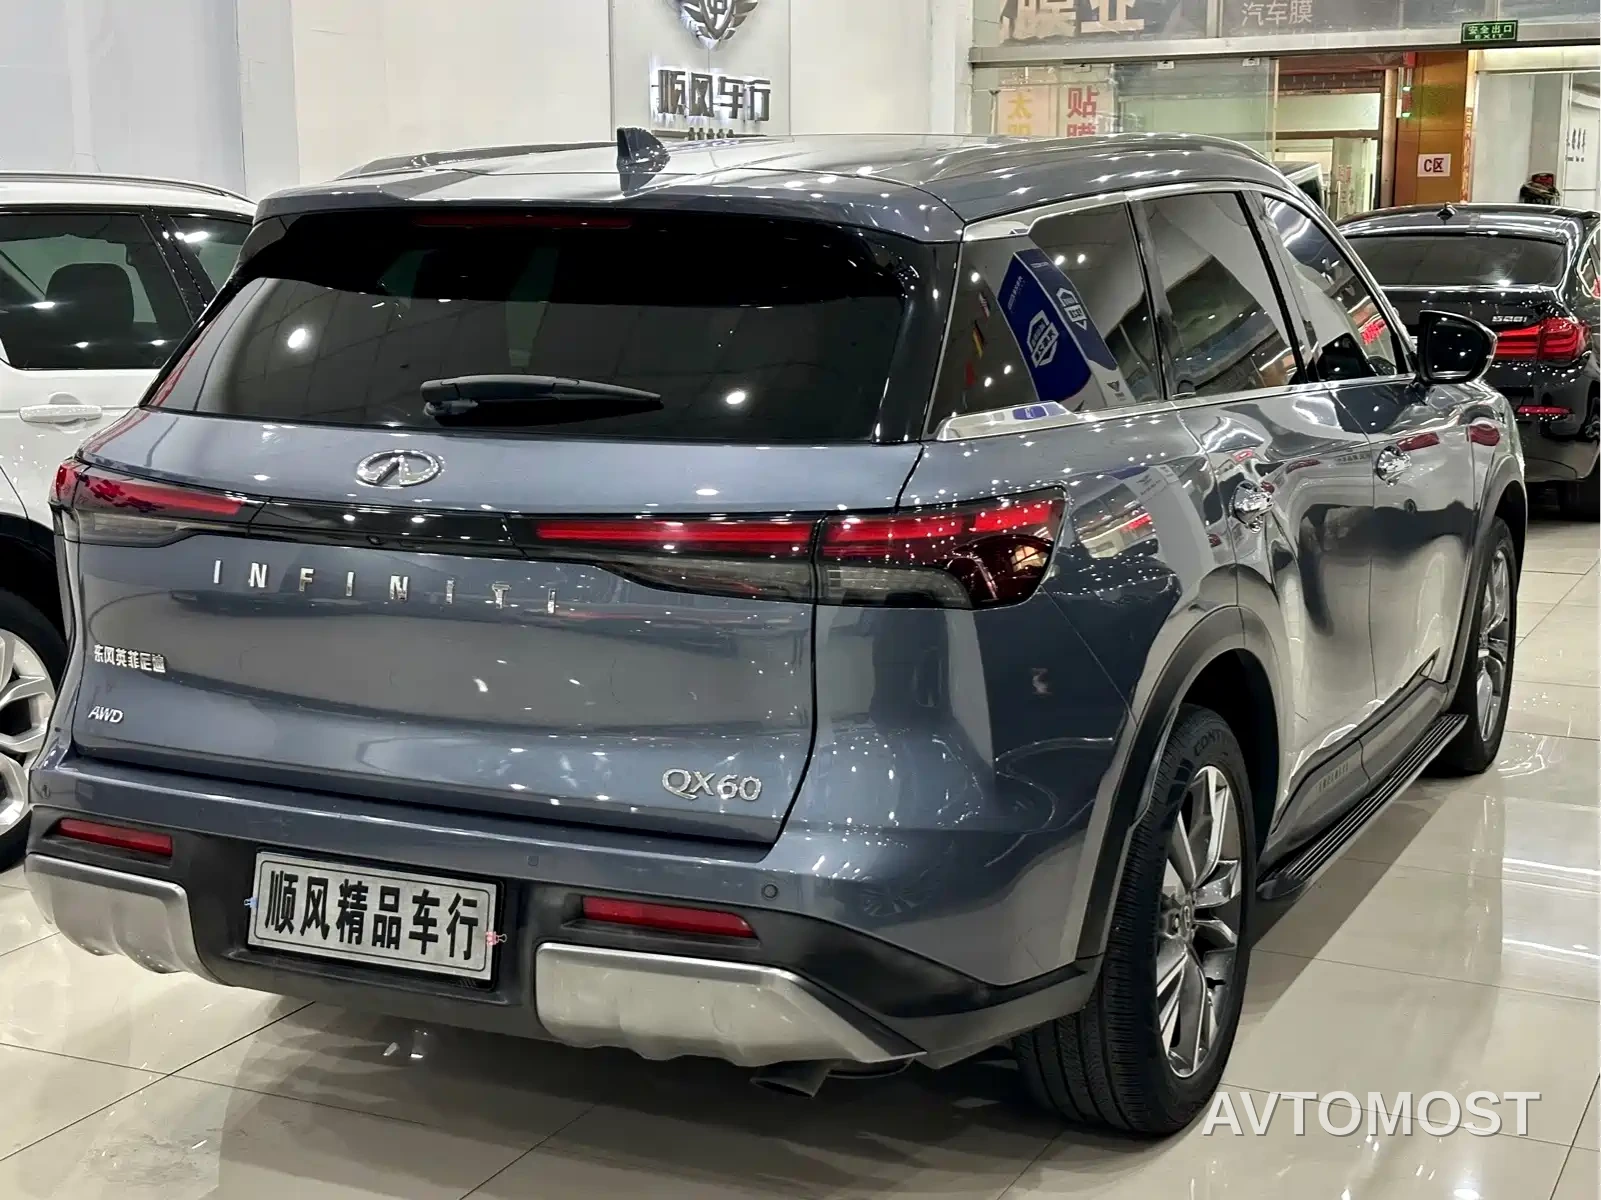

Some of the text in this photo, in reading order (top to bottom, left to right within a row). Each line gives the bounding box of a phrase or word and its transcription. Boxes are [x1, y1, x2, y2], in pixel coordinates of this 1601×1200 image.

[1241, 0, 1313, 26] 汽车膜
[1468, 25, 1512, 35] 安全出口
[651, 69, 771, 121] 顺风车行
[1424, 158, 1444, 172] C区
[213, 559, 556, 614] INFINITI
[94, 644, 166, 673] 东风英菲尼迪
[88, 706, 123, 723] AWD
[662, 768, 762, 800] QX60
[265, 870, 479, 961] 顺风精品车行
